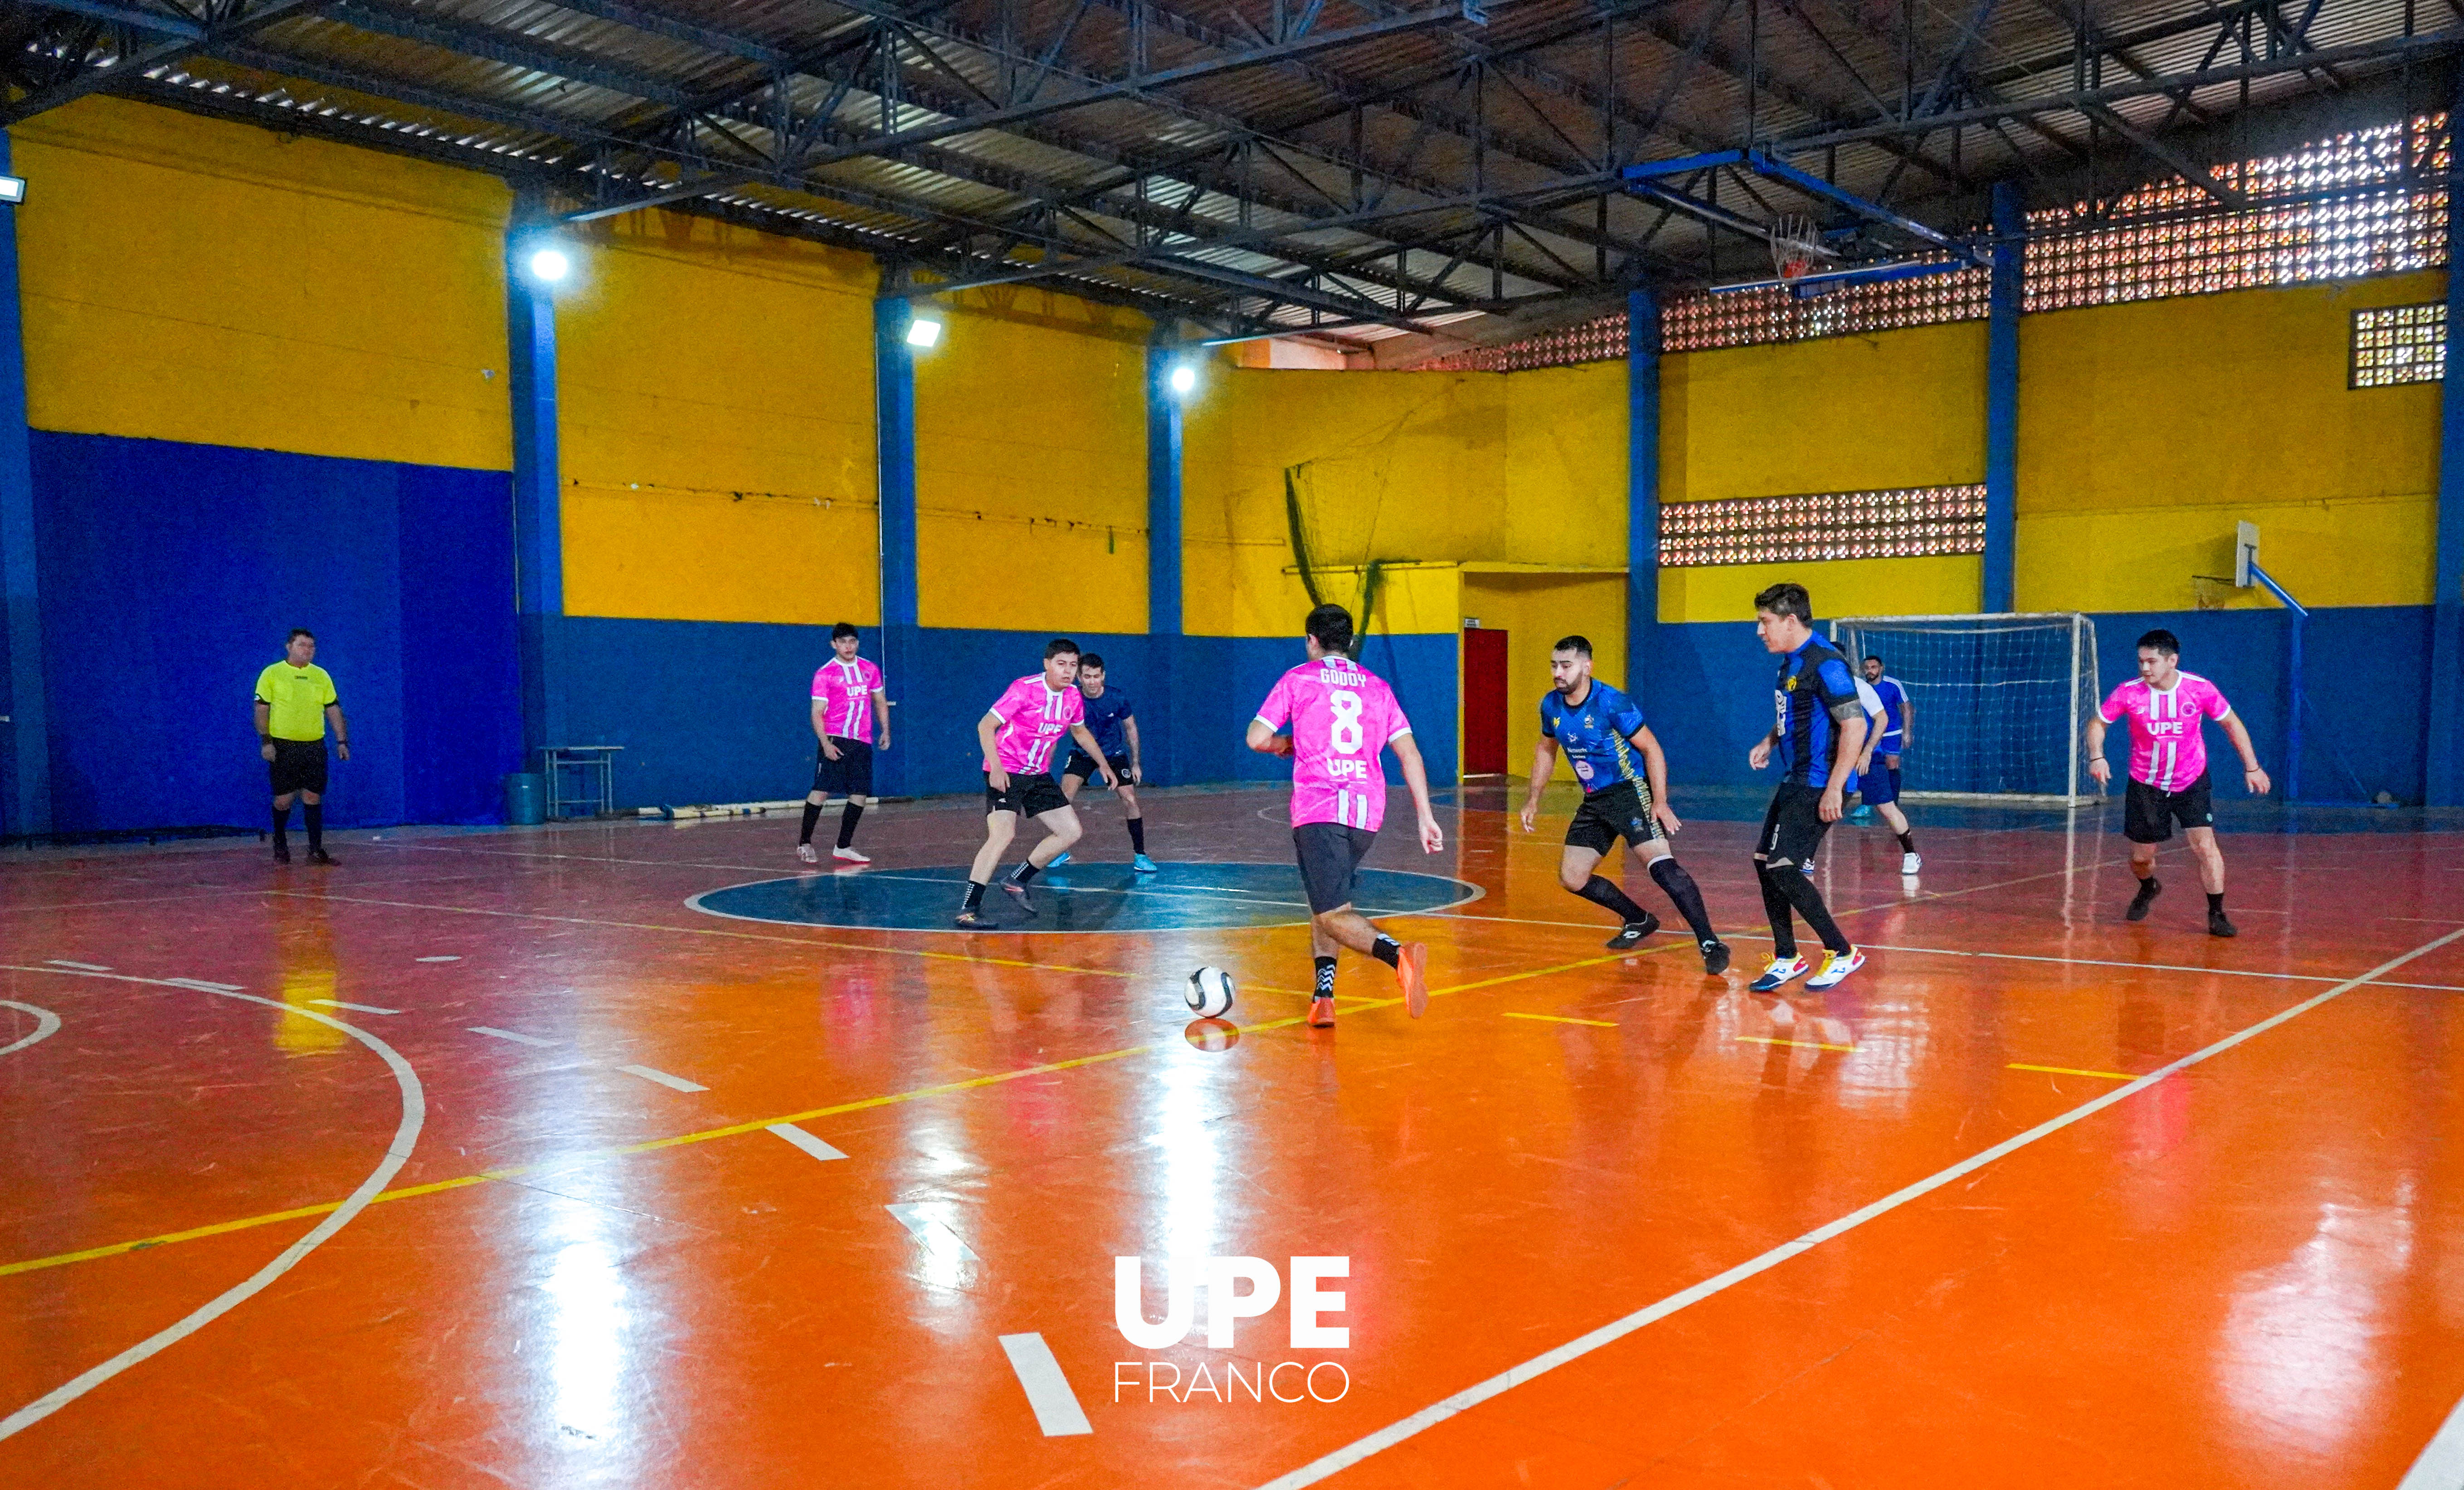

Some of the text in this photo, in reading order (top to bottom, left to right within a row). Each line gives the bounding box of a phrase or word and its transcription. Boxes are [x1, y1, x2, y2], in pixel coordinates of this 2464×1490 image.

[1320, 668, 1366, 687] GODOY
[847, 685, 867, 697] UPE
[1330, 690, 1363, 754] 8
[2147, 721, 2183, 735] UPE
[1327, 758, 1367, 779] UPE
